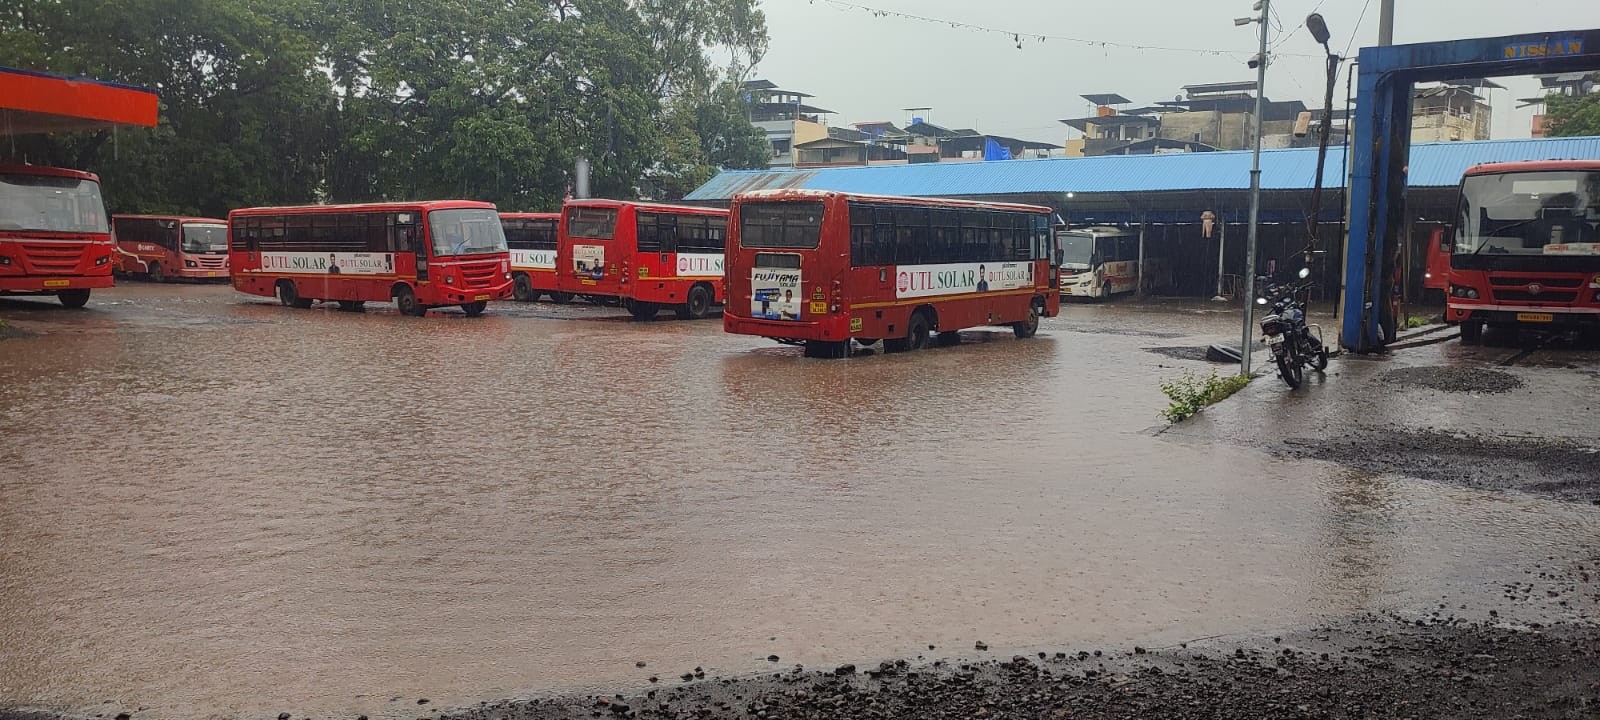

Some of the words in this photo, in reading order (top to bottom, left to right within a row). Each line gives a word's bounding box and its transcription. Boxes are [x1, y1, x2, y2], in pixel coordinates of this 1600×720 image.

[1504, 42, 1582, 58] NISSAN
[271, 256, 291, 269] UTL
[292, 257, 327, 270] SOLAR
[346, 259, 359, 267] UTL
[360, 260, 382, 268] SOLAR
[690, 257, 712, 271] UTL
[910, 271, 935, 290] UTL
[937, 270, 975, 288] SOLAR
[993, 272, 1006, 282] UTL
[1006, 271, 1025, 280] SOLAR
